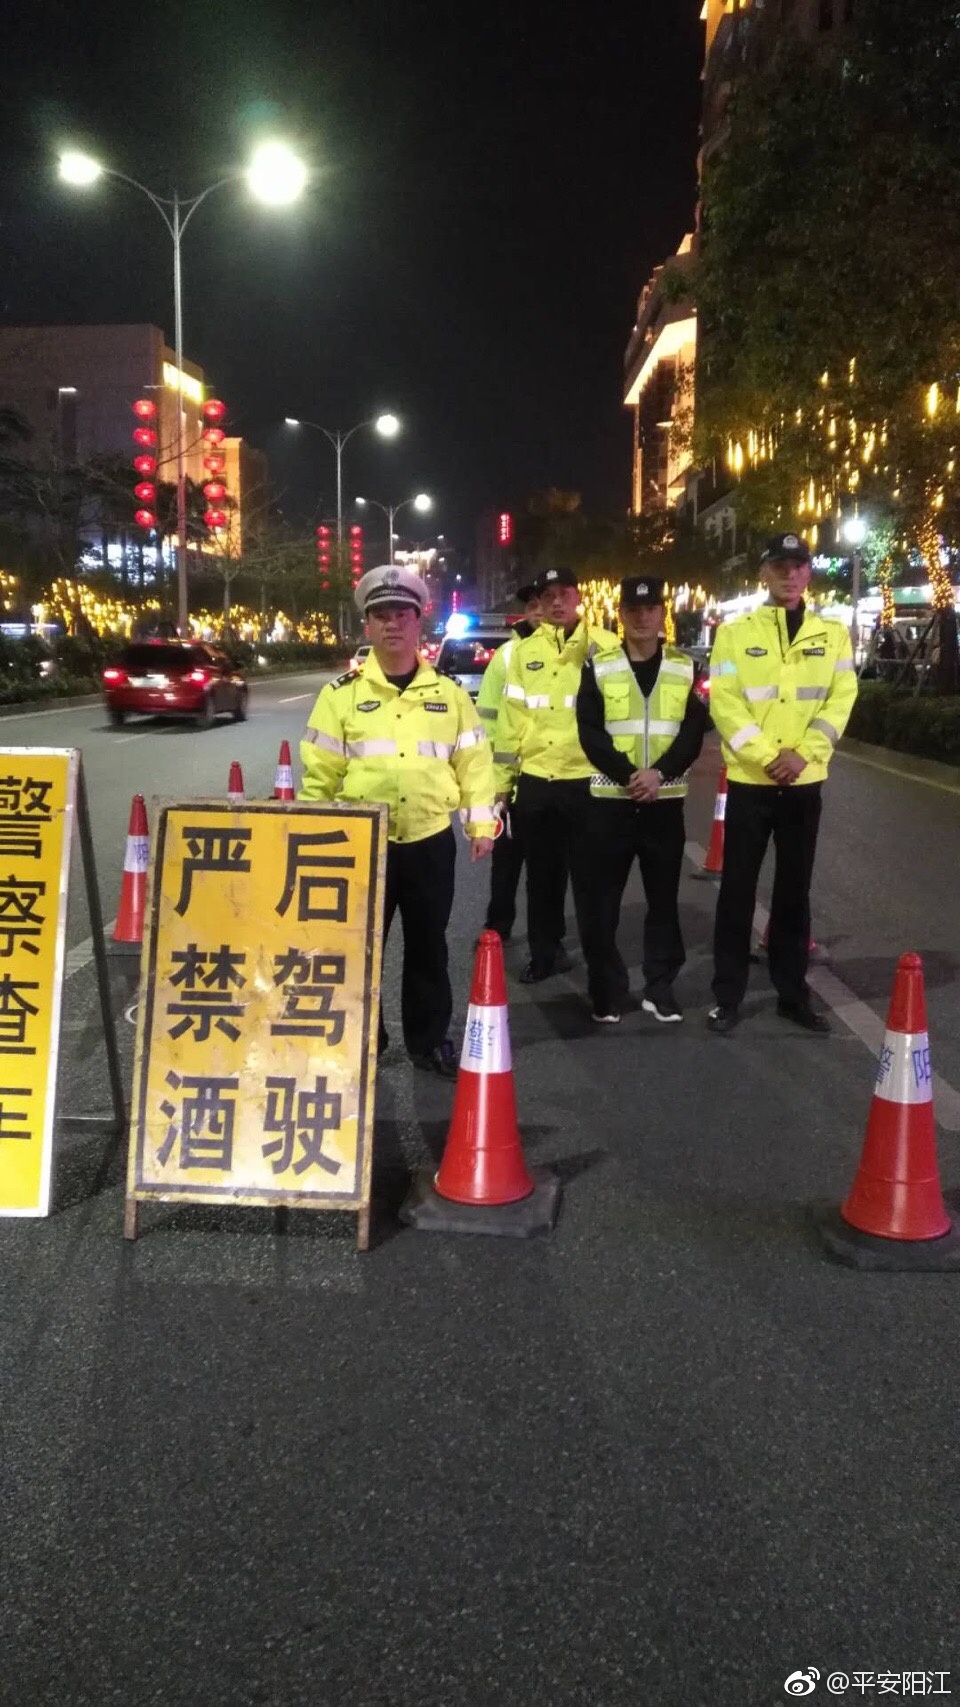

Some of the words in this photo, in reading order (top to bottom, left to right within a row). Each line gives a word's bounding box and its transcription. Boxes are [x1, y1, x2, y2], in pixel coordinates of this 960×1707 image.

[157, 827, 252, 1171] 严禁酒
[262, 830, 355, 1175] 后驾驶
